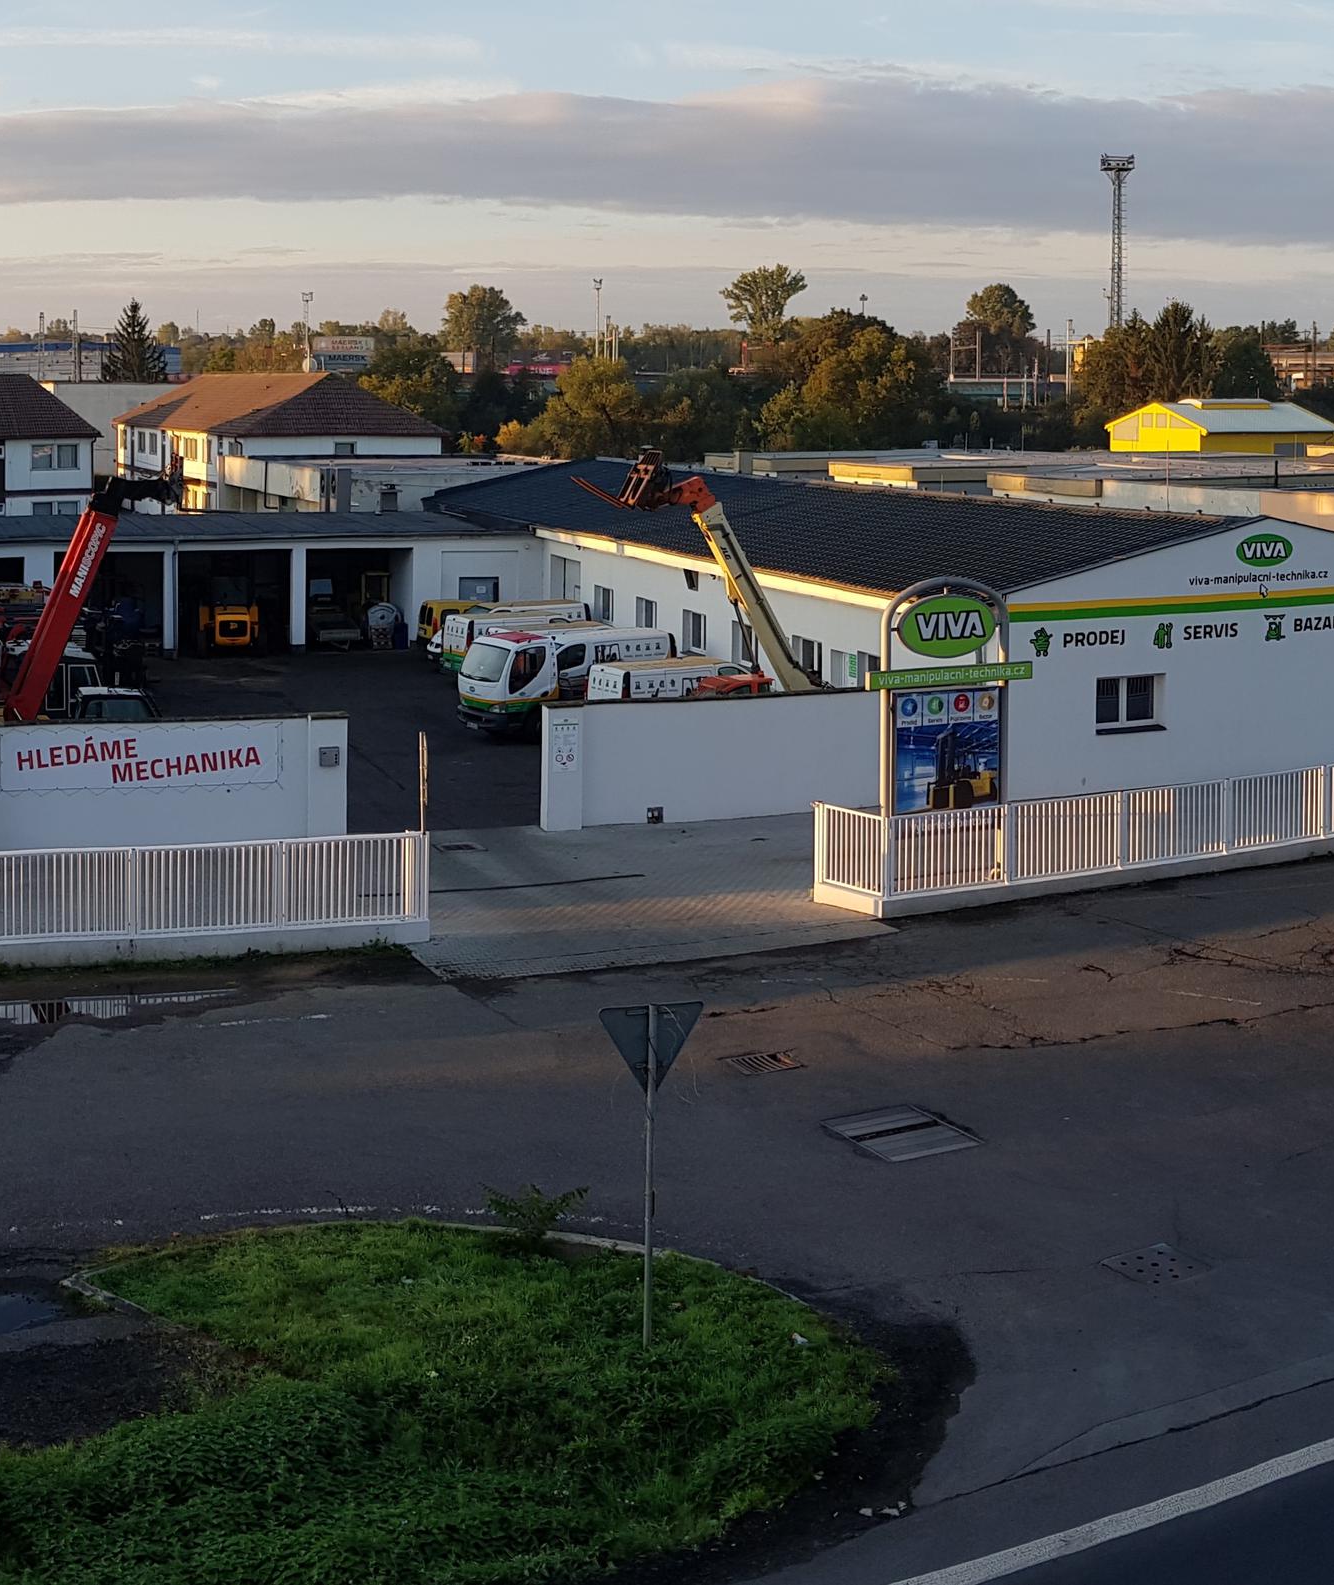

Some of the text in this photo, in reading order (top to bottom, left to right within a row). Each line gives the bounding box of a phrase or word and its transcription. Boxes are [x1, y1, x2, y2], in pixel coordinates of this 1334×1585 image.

[69, 522, 106, 598] MANISCOPIC
[1241, 541, 1288, 559] VIVA
[1188, 570, 1329, 585] viva-manipulacni-technika.cz
[916, 610, 986, 641] VIVA
[1063, 629, 1126, 648] PRODEJ
[1183, 623, 1238, 641] SERVIS
[878, 665, 1025, 686] viva-manipulacni-technika.cz
[17, 736, 138, 771] HLEDÁME
[111, 746, 261, 784] MECHANIKA
